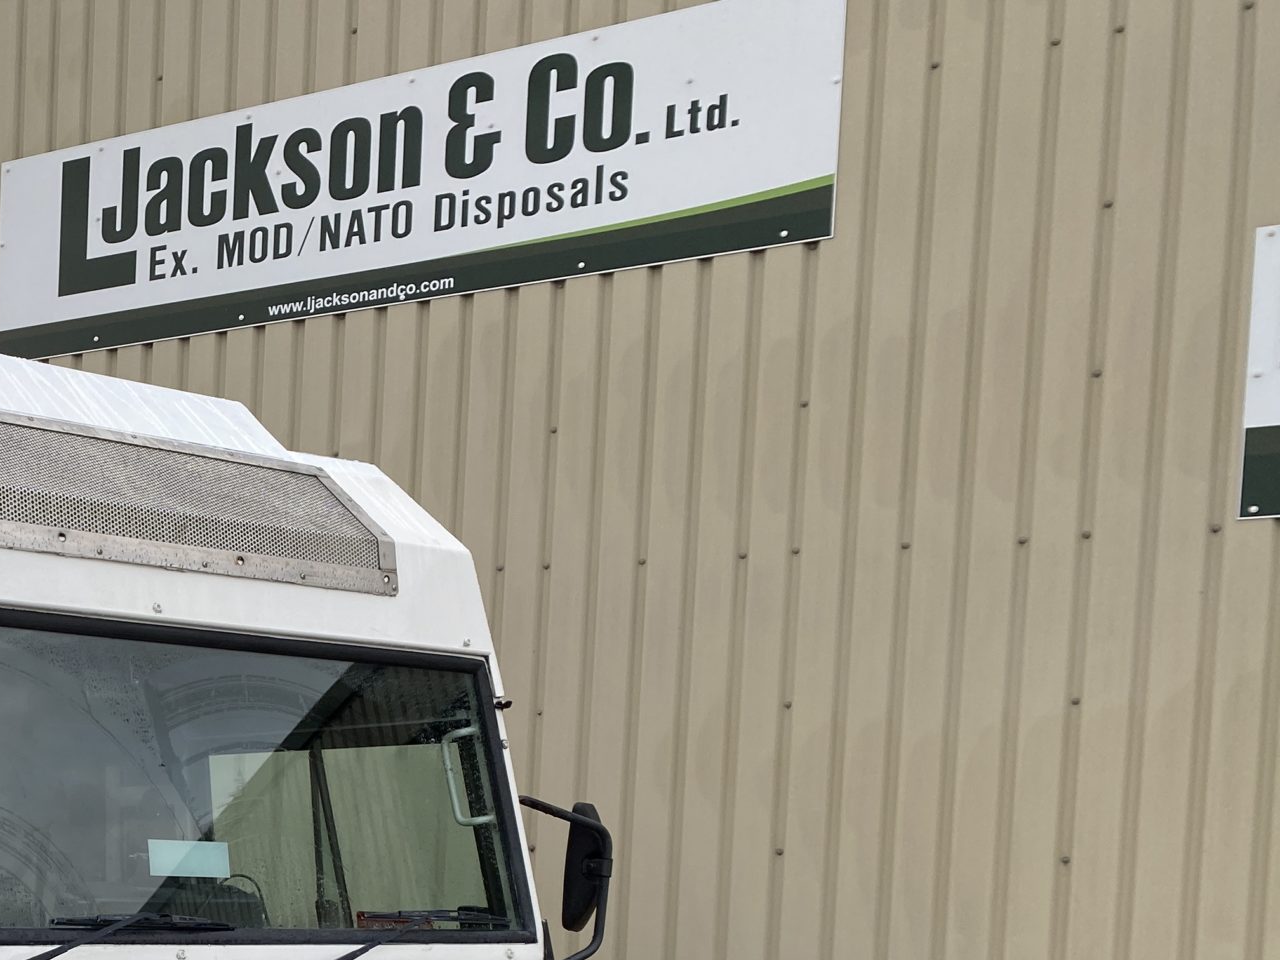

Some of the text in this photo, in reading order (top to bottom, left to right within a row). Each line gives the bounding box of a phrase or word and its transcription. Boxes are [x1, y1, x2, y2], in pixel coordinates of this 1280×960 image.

[445, 71, 502, 180] &
[525, 53, 650, 165] Co.
[665, 93, 740, 140] Ltd.
[149, 165, 629, 282] Ex. MOD/NATO Disposals
[268, 277, 455, 317] www.ljacksonandco.com
